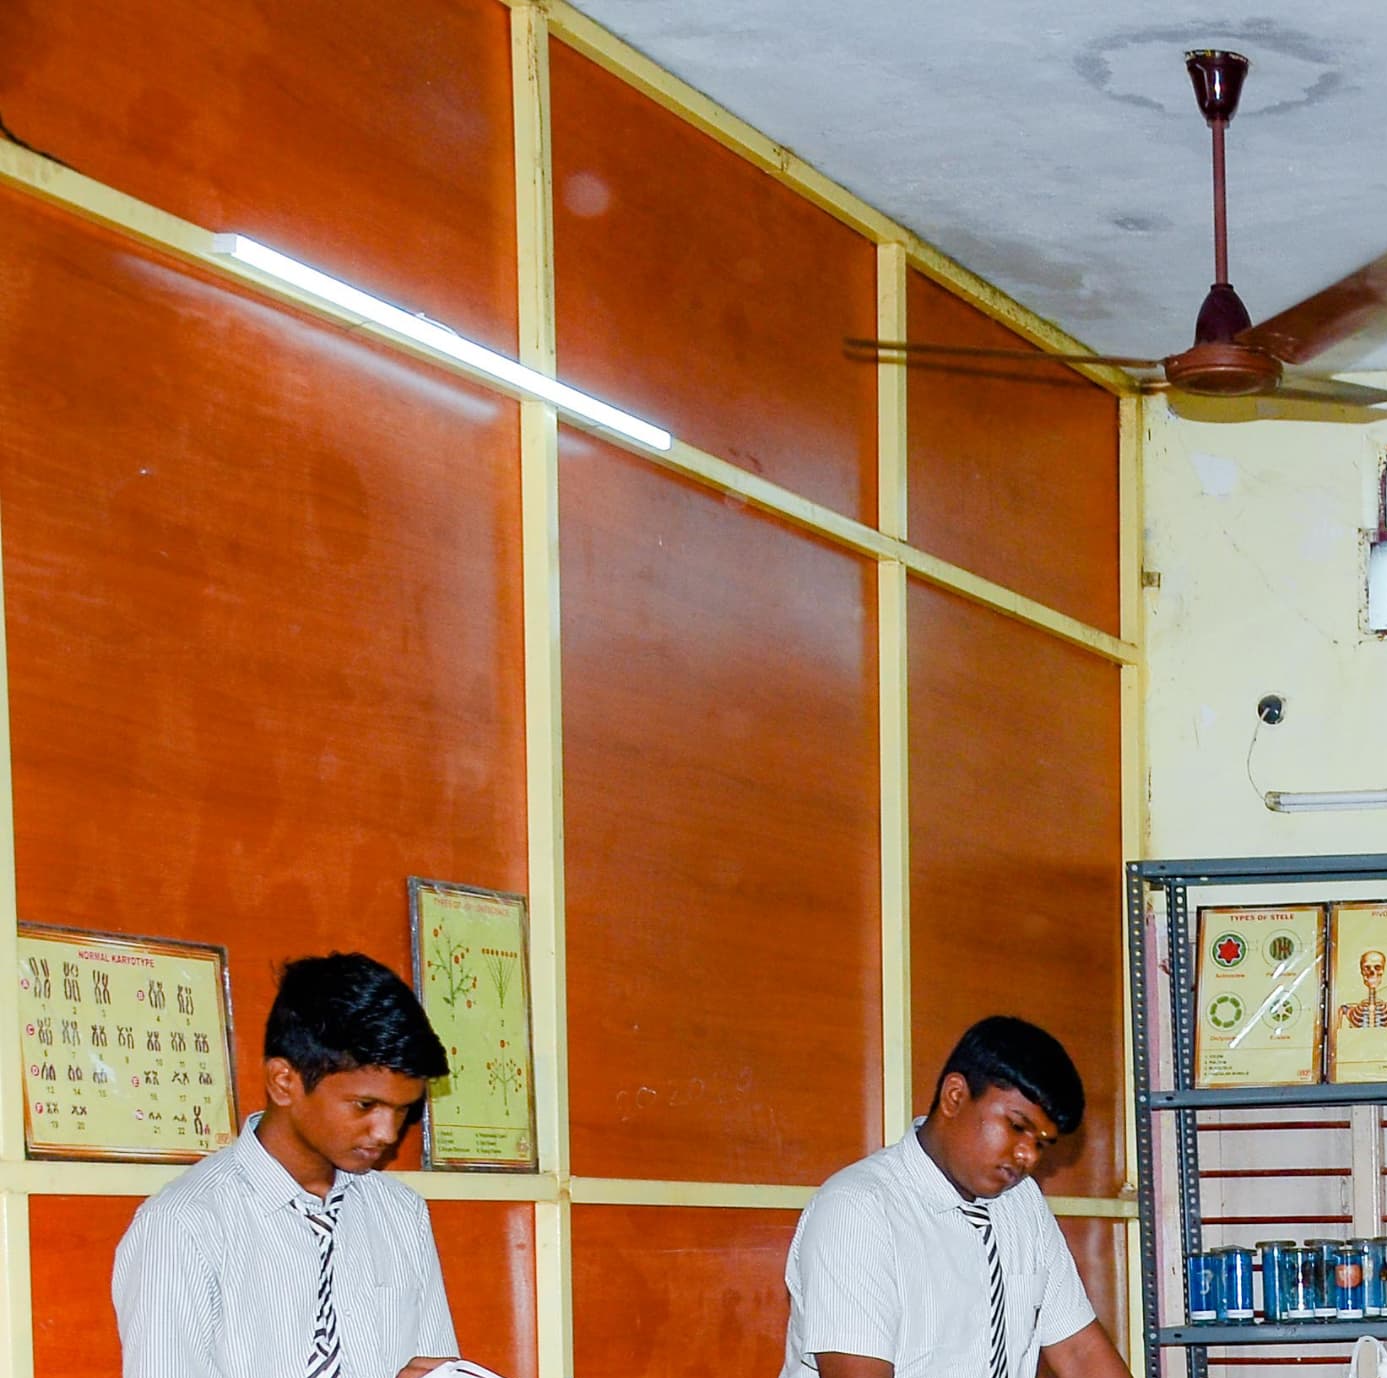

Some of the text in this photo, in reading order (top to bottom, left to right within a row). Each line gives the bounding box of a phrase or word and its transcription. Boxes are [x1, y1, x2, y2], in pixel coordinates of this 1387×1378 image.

[1230, 914, 1255, 922] TYPES
[1270, 913, 1295, 921] STELE
[78, 951, 155, 968] NORMAL KARYOTYPE
